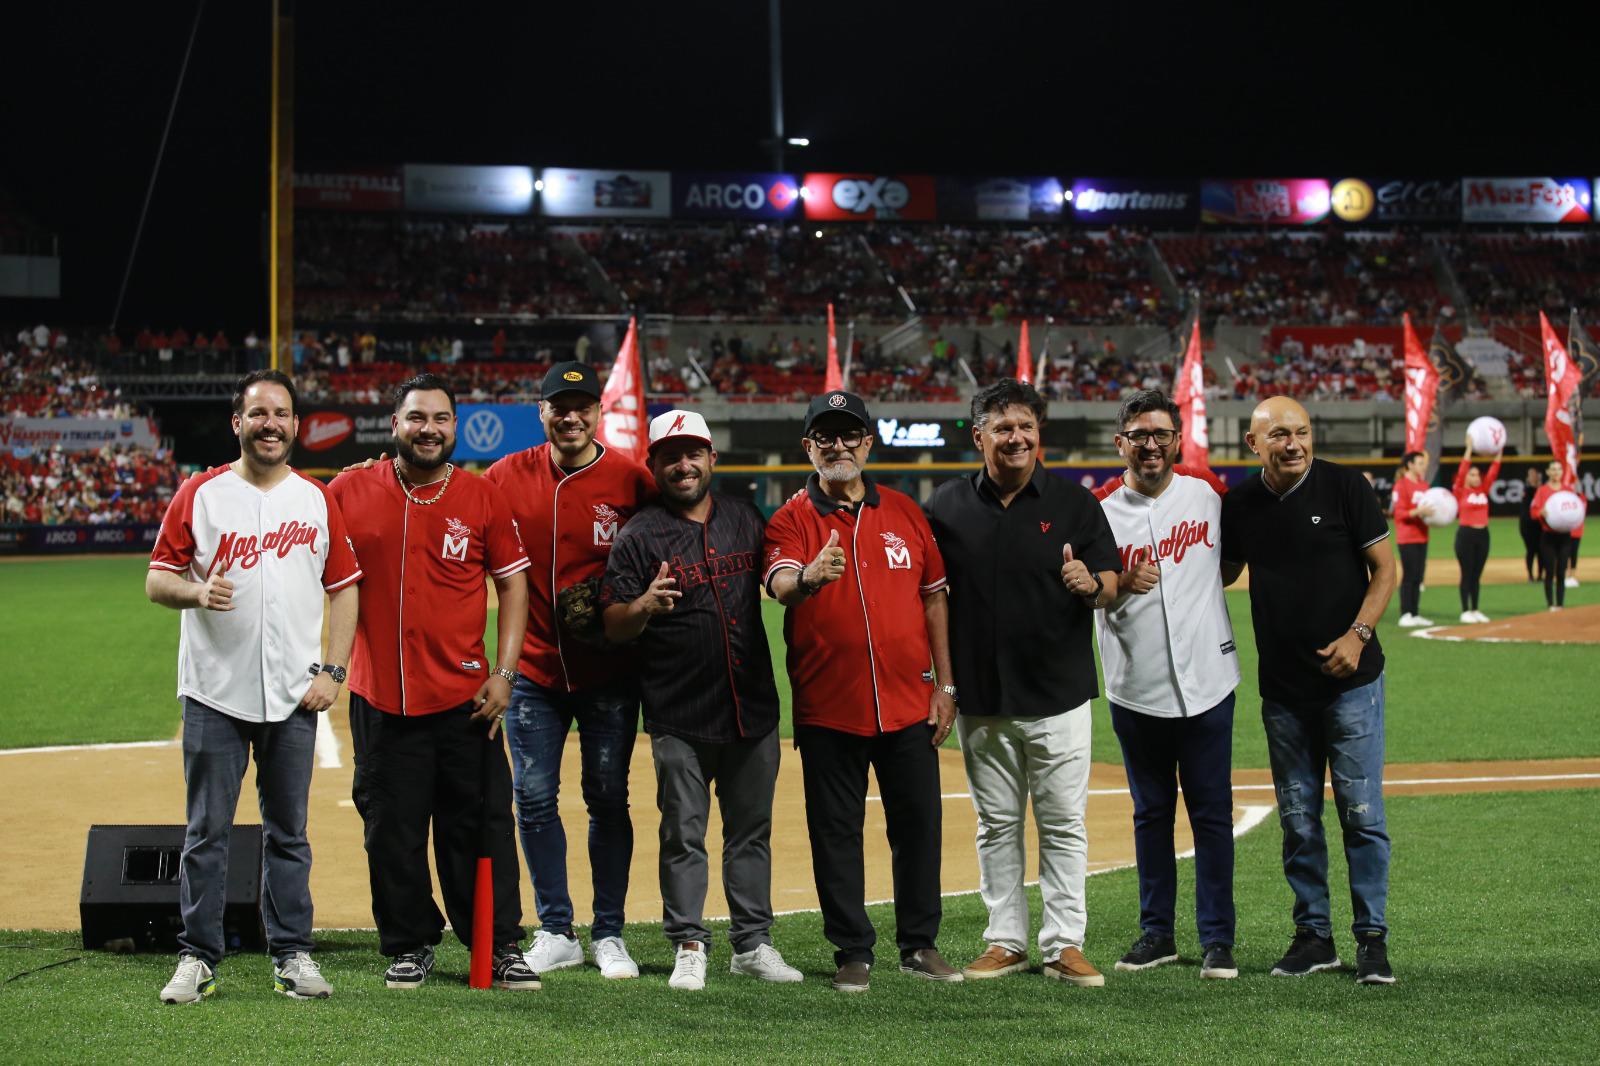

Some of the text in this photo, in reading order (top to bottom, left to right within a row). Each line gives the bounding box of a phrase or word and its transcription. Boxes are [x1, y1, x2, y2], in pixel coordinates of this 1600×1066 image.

[686, 183, 765, 210] ARCO
[832, 177, 909, 213] exa
[207, 520, 318, 577] Mazatlán
